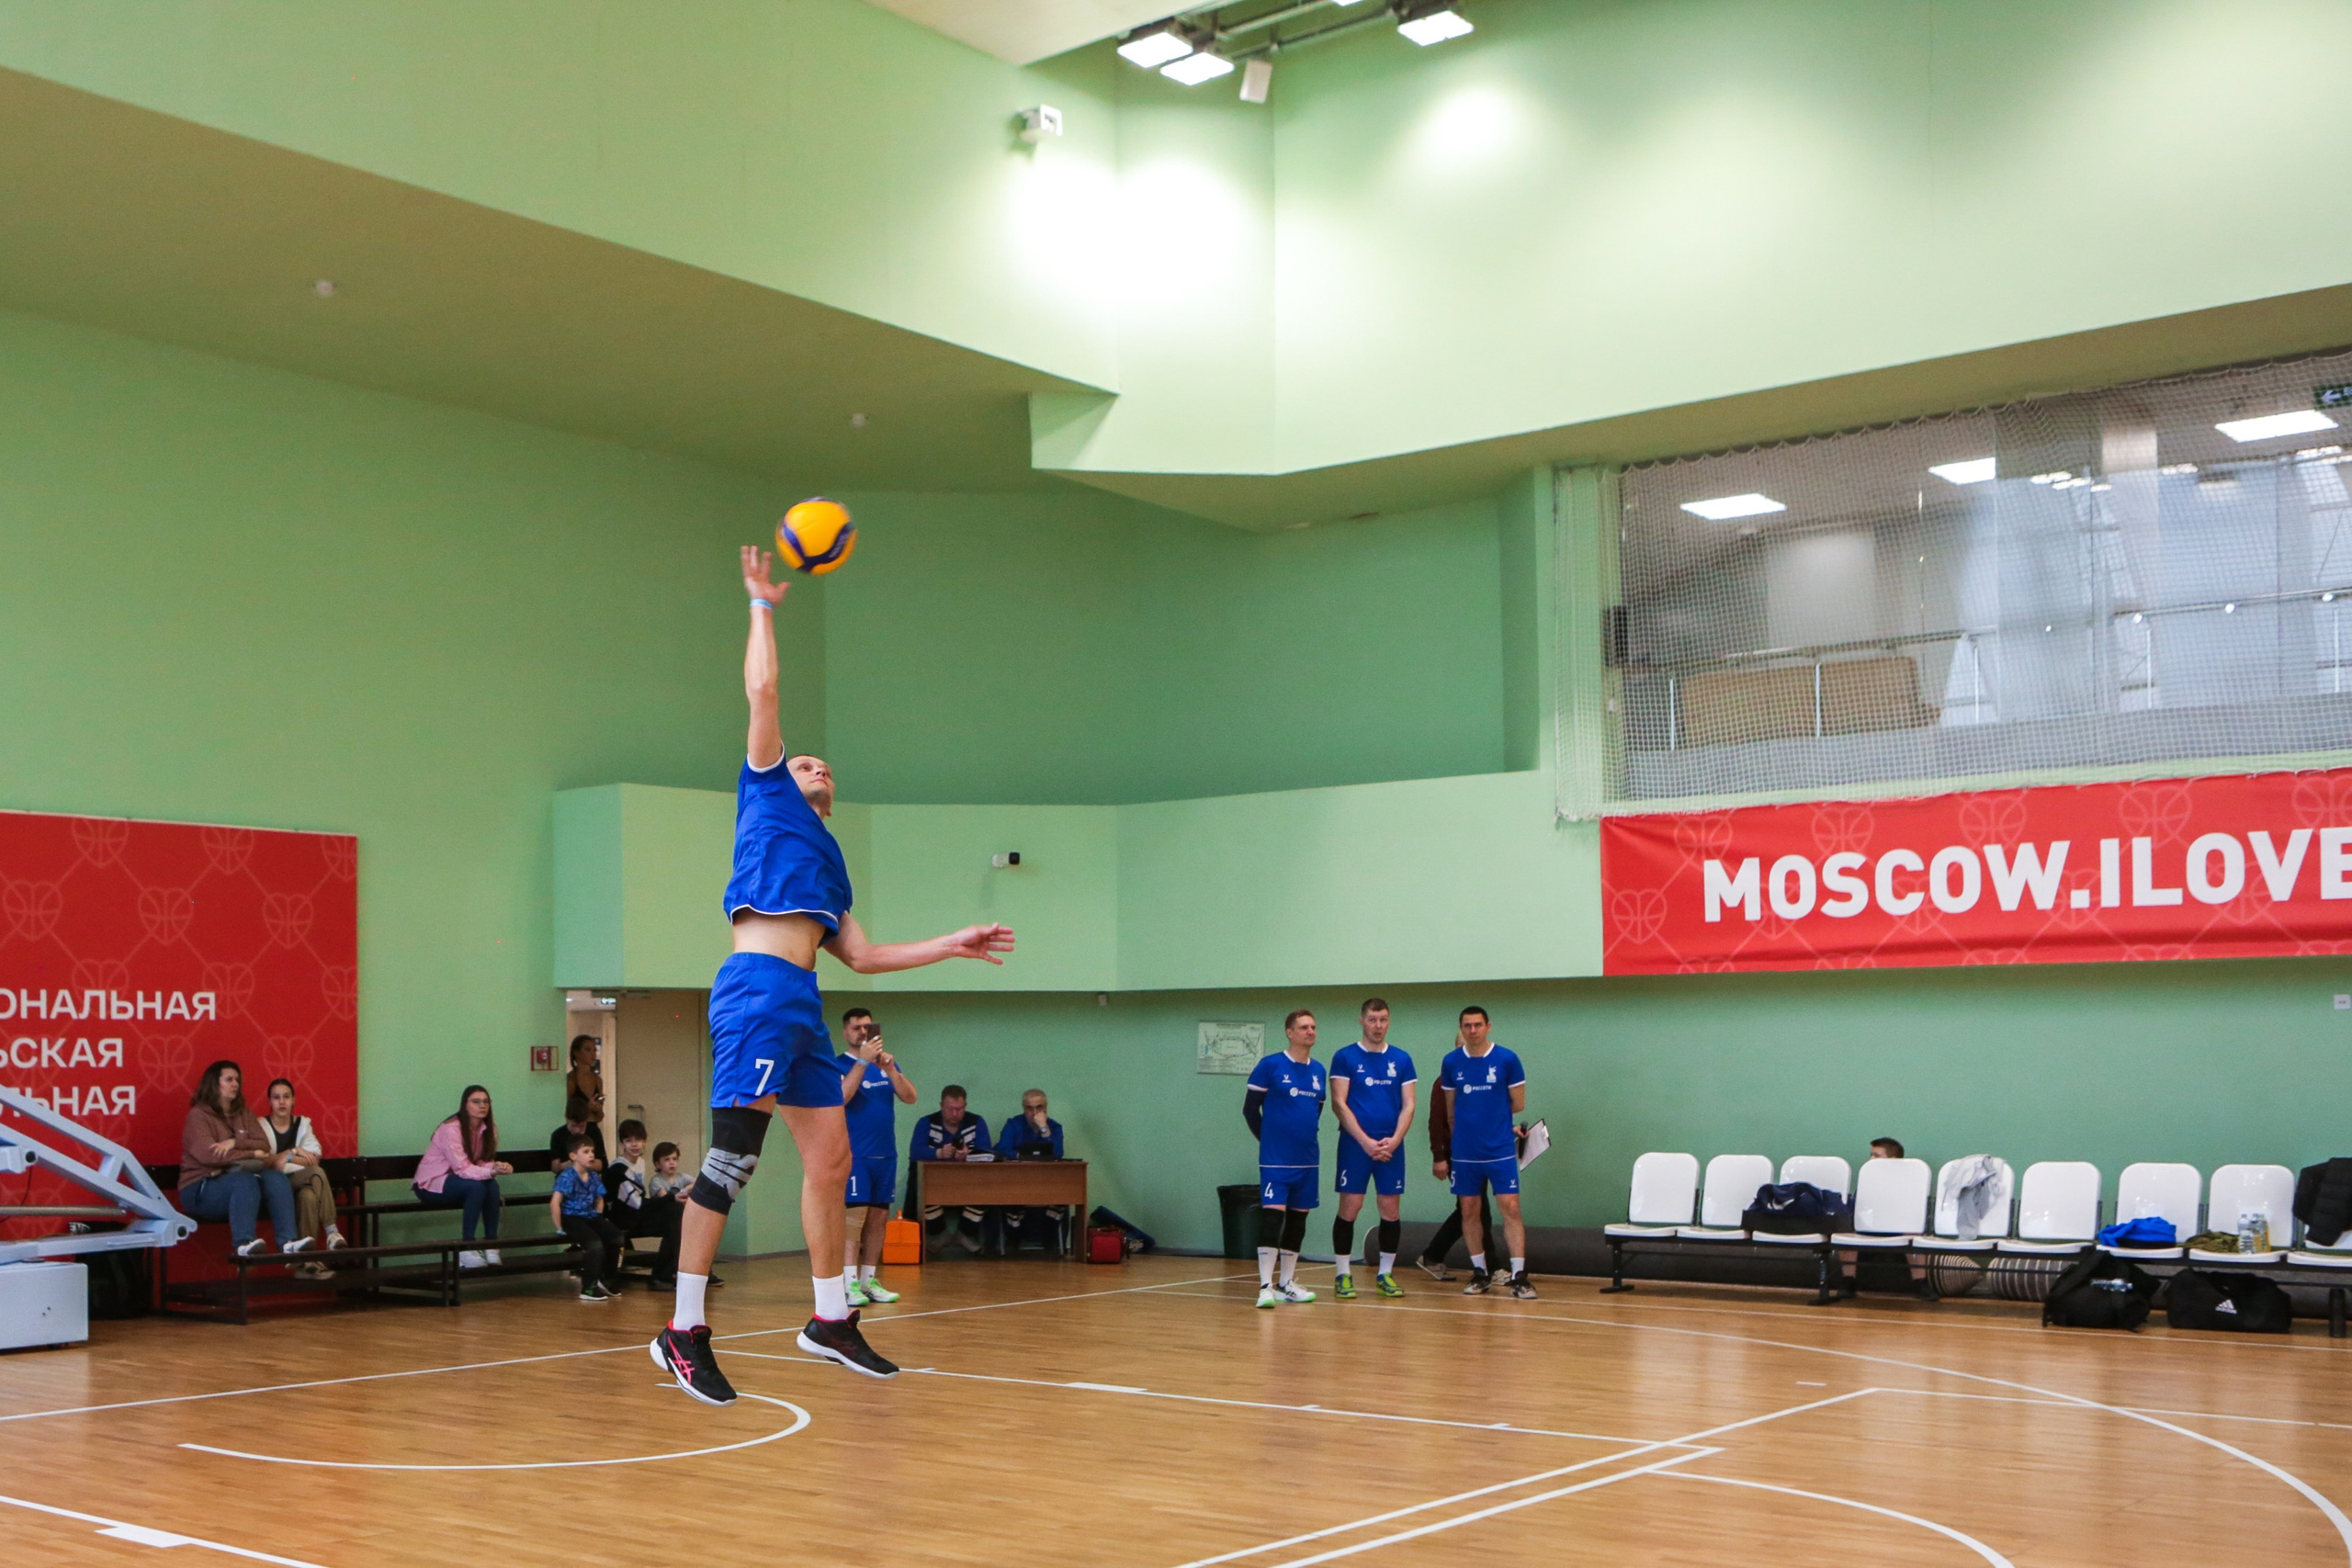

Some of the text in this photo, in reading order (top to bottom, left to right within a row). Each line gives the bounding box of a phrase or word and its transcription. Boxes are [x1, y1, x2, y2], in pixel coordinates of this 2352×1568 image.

[1702, 826, 2352, 922] MOSCOW.ILOVE
[0, 987, 216, 1021] ОНАЛЬНАЯ
[754, 1058, 775, 1097] 7
[850, 1175, 857, 1196] 1
[1264, 1181, 1274, 1200] 4
[1340, 1168, 1348, 1187] 6
